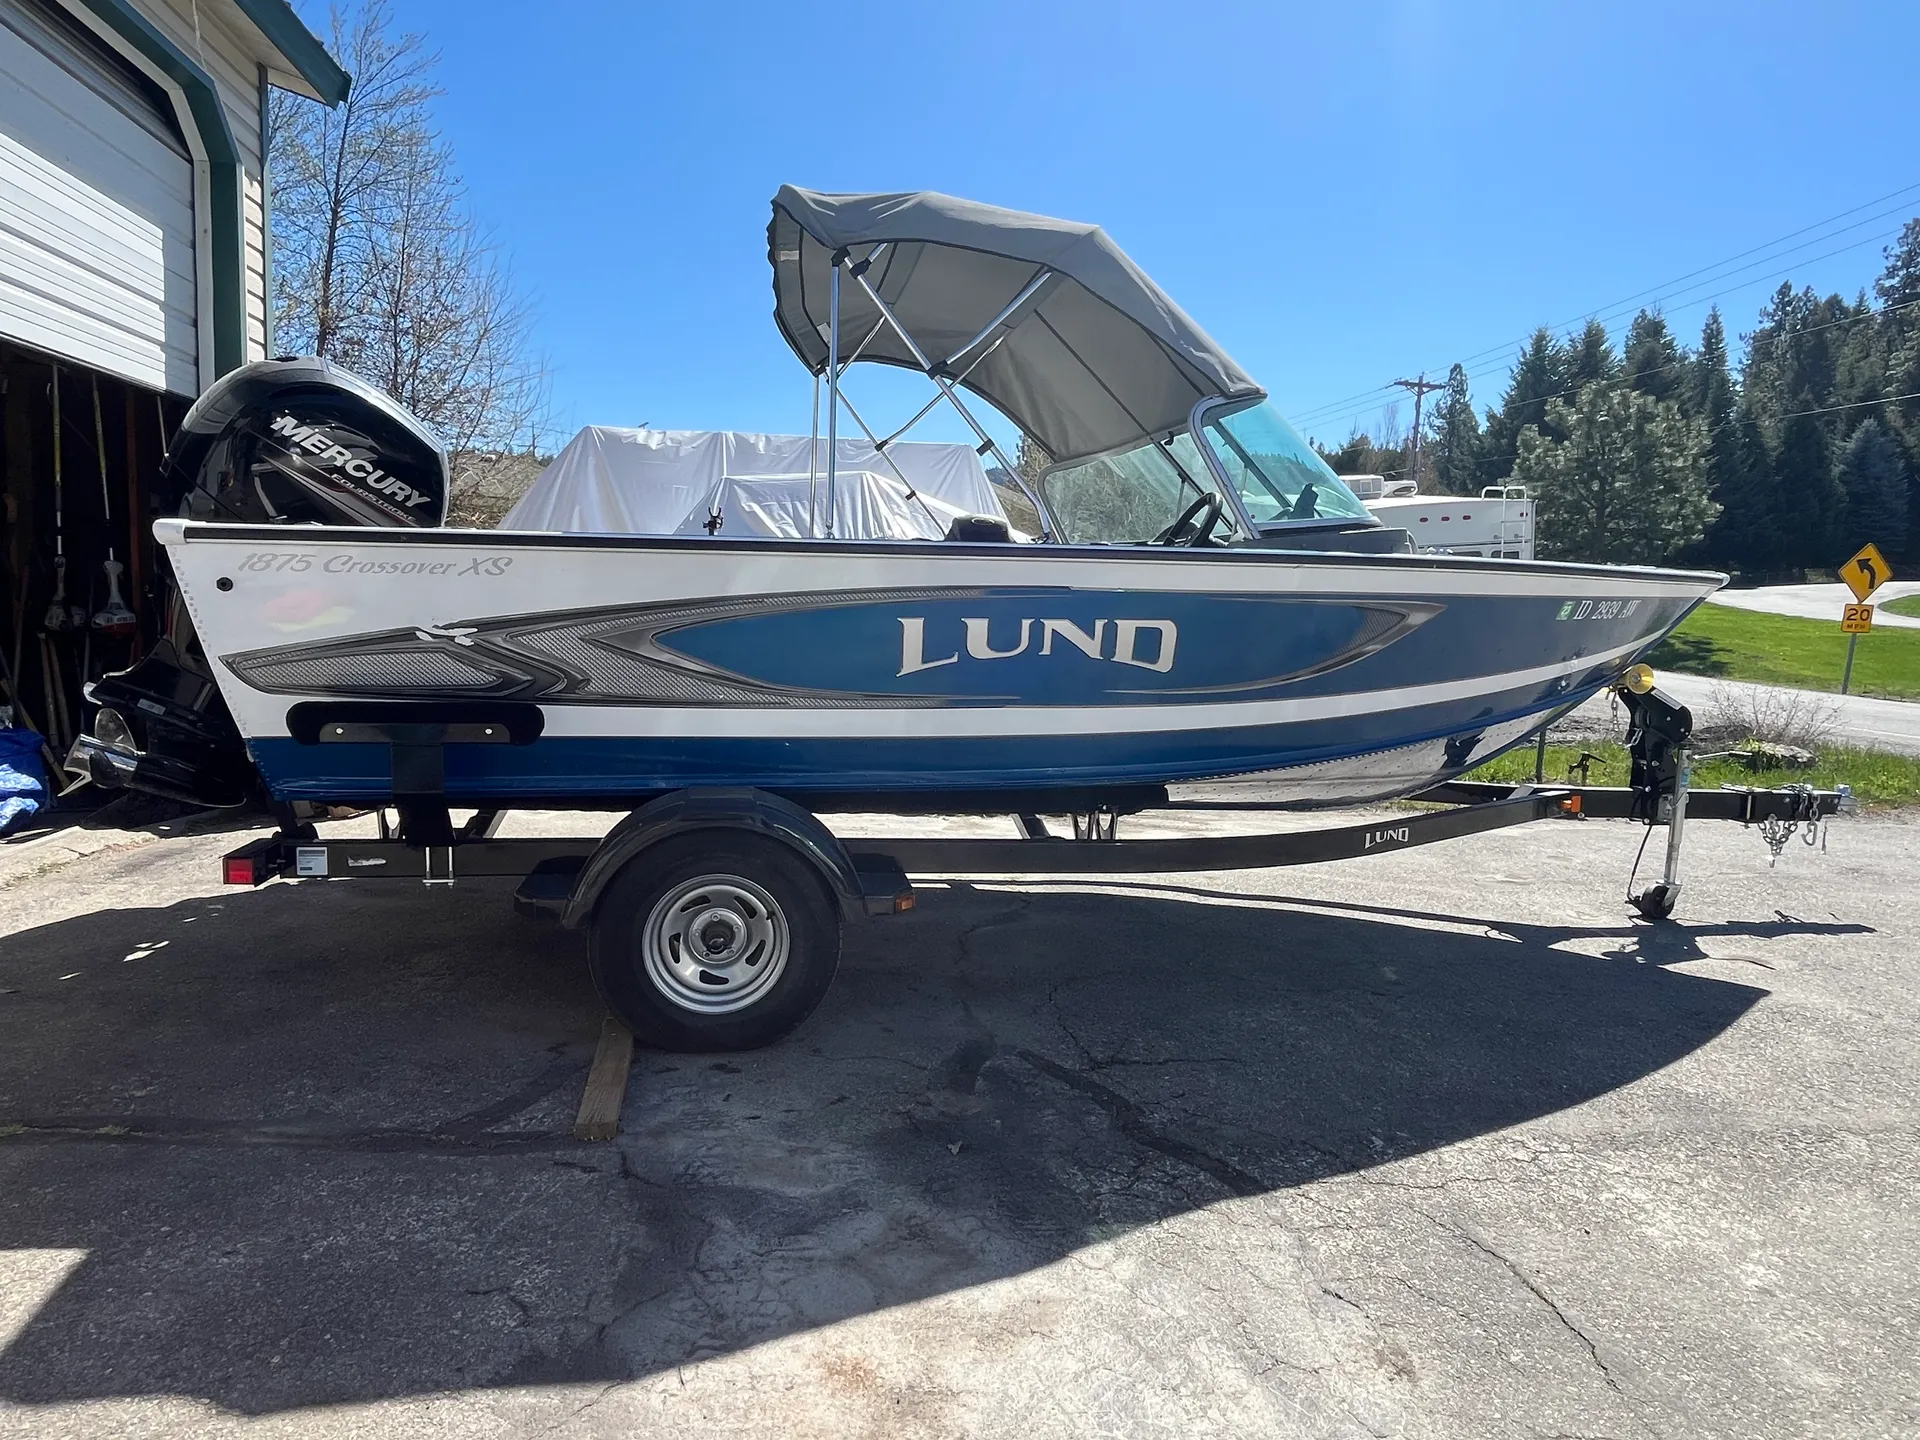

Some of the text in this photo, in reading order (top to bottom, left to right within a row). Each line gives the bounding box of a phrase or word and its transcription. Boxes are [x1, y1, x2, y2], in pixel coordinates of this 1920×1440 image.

[270, 415, 431, 508] MERCURY
[330, 473, 417, 522] FOURSTROKE
[238, 553, 513, 577] 1875 Crossover XS
[1573, 600, 1593, 619] ID
[1846, 608, 1870, 621] 20
[896, 617, 1178, 677] LUND
[1364, 827, 1409, 849] LUND
